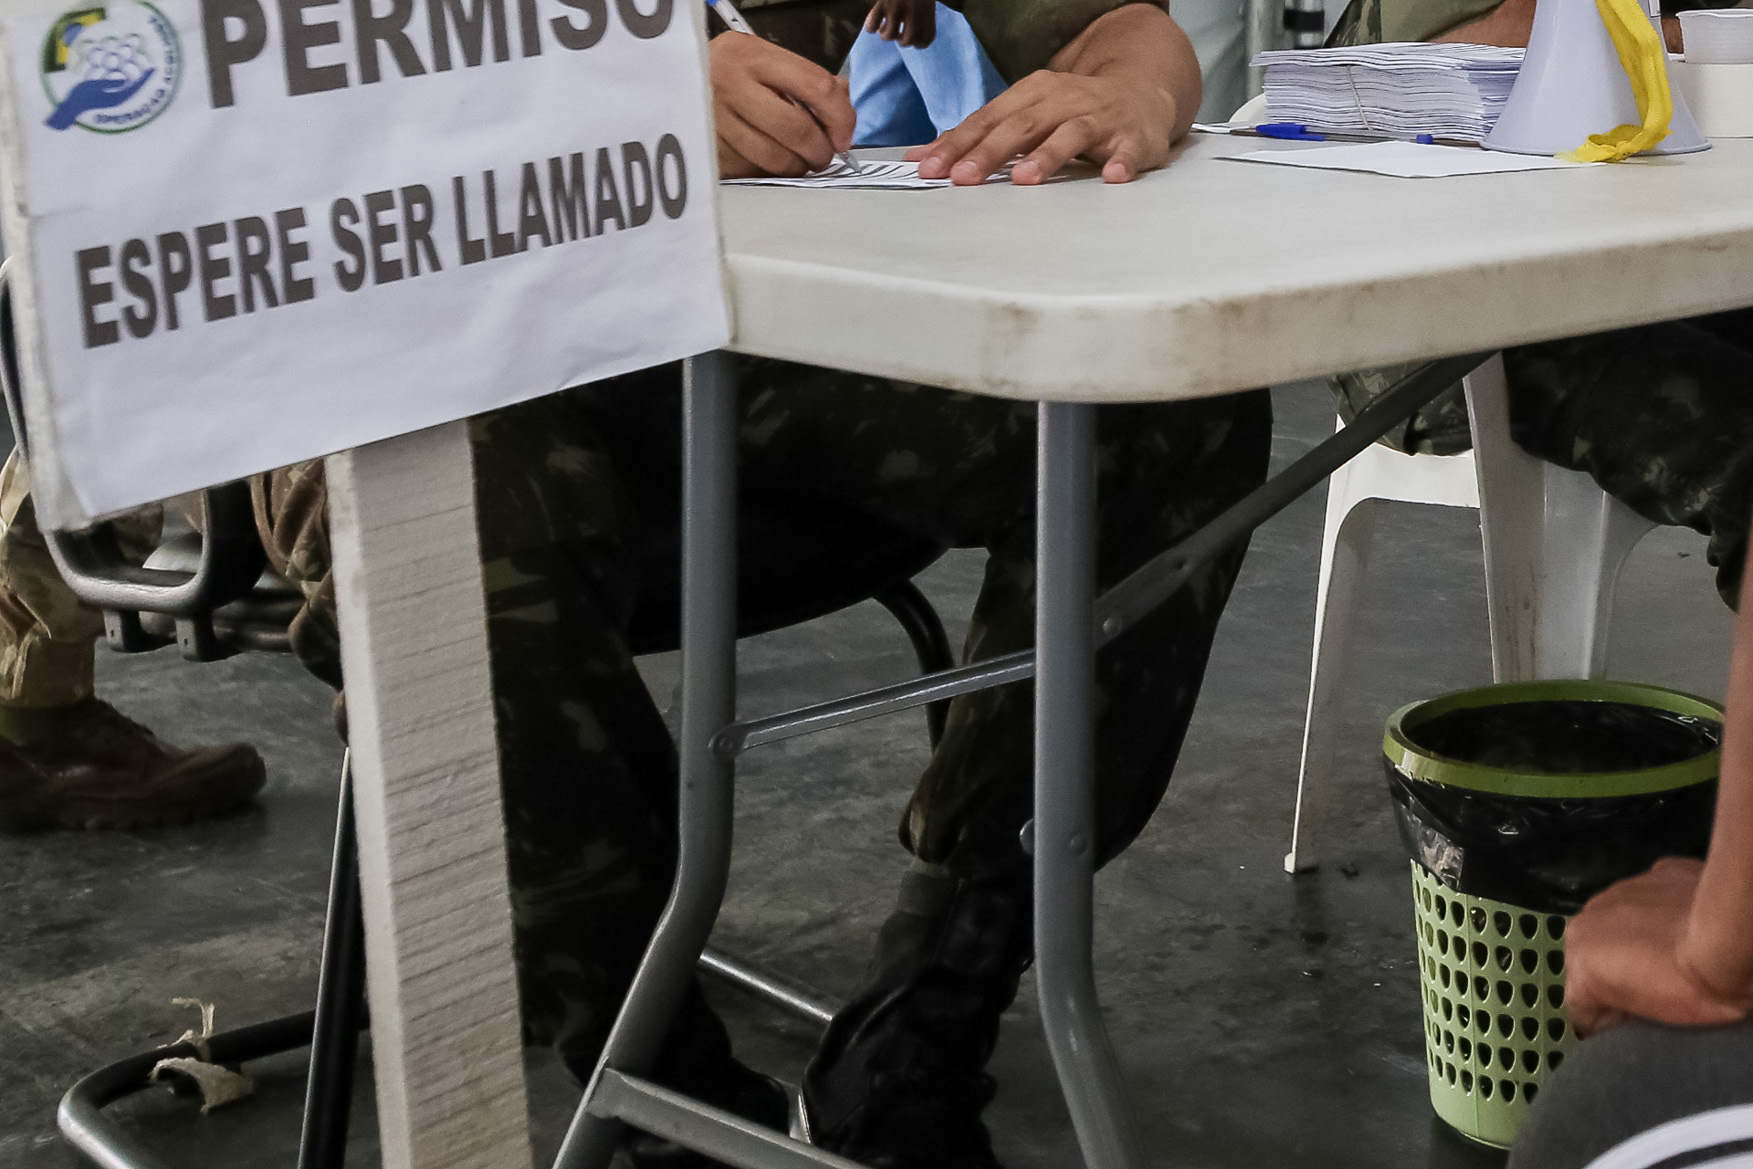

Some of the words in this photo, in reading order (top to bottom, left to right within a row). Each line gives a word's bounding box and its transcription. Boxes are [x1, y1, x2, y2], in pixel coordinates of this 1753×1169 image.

[74, 205, 314, 350] ESPERE
[329, 183, 442, 293] SER
[453, 132, 689, 267] LLAMADO
